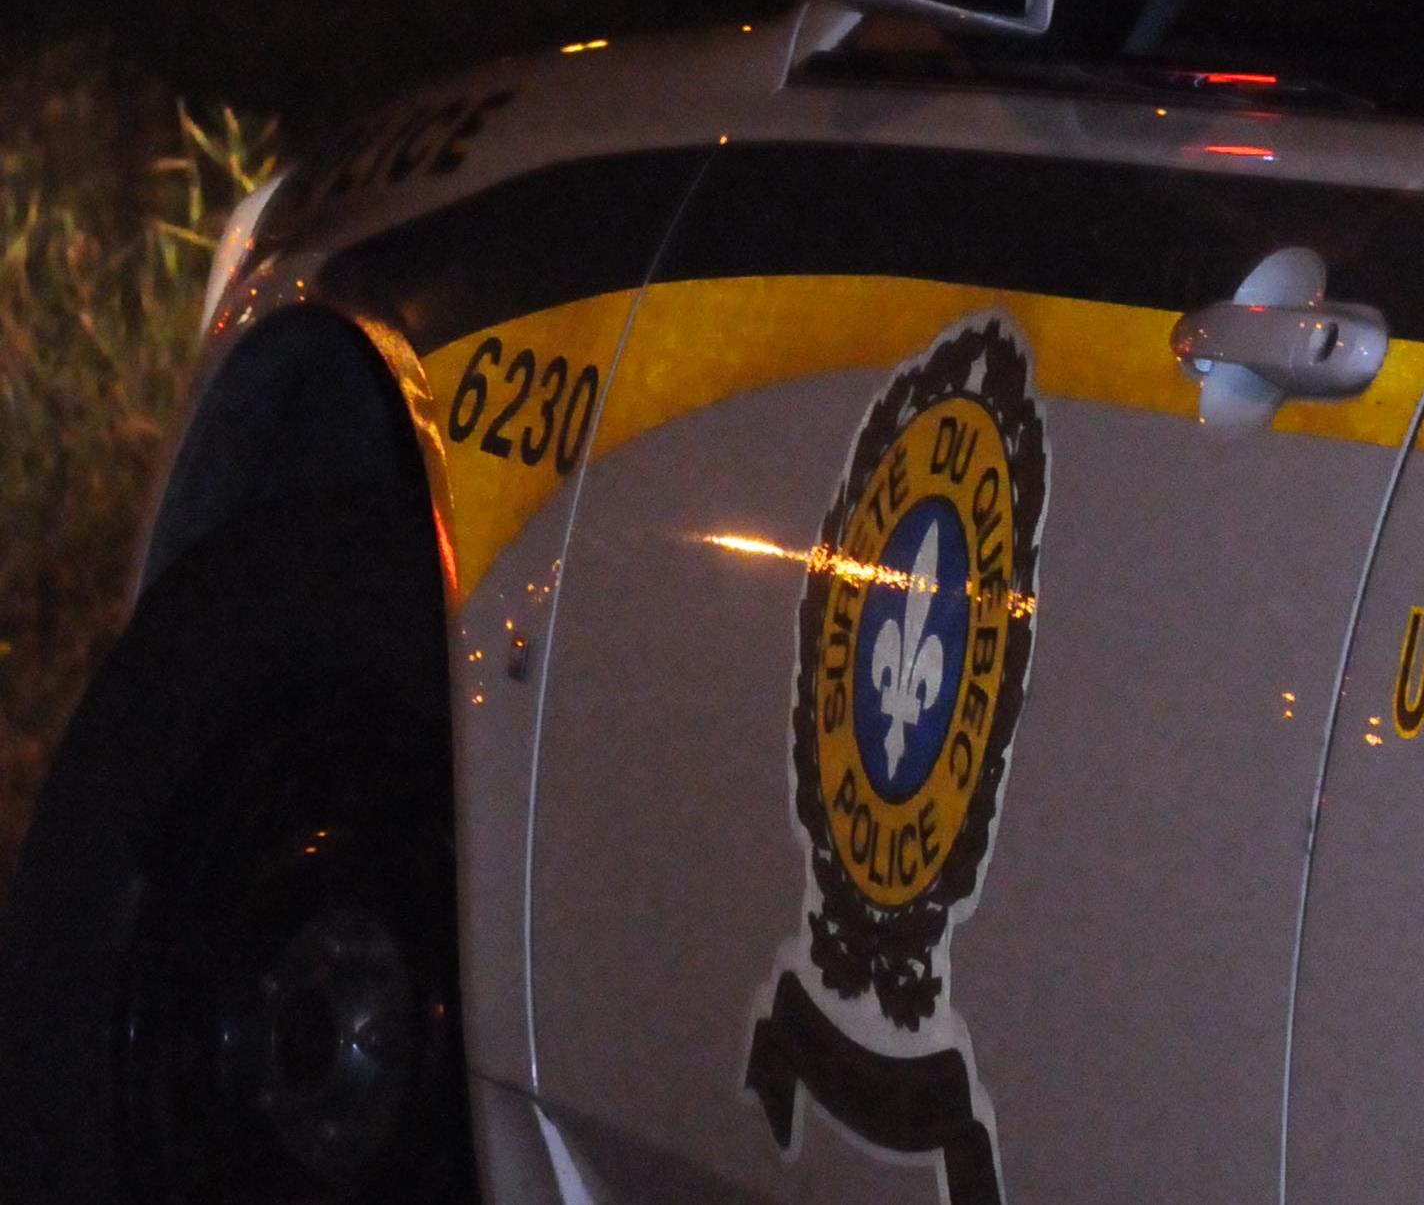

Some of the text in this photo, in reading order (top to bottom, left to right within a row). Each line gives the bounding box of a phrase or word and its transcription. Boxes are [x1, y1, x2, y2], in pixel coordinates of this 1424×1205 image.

[447, 335, 600, 476] 6230
[930, 415, 979, 486] DU
[832, 767, 942, 889] POLICE
